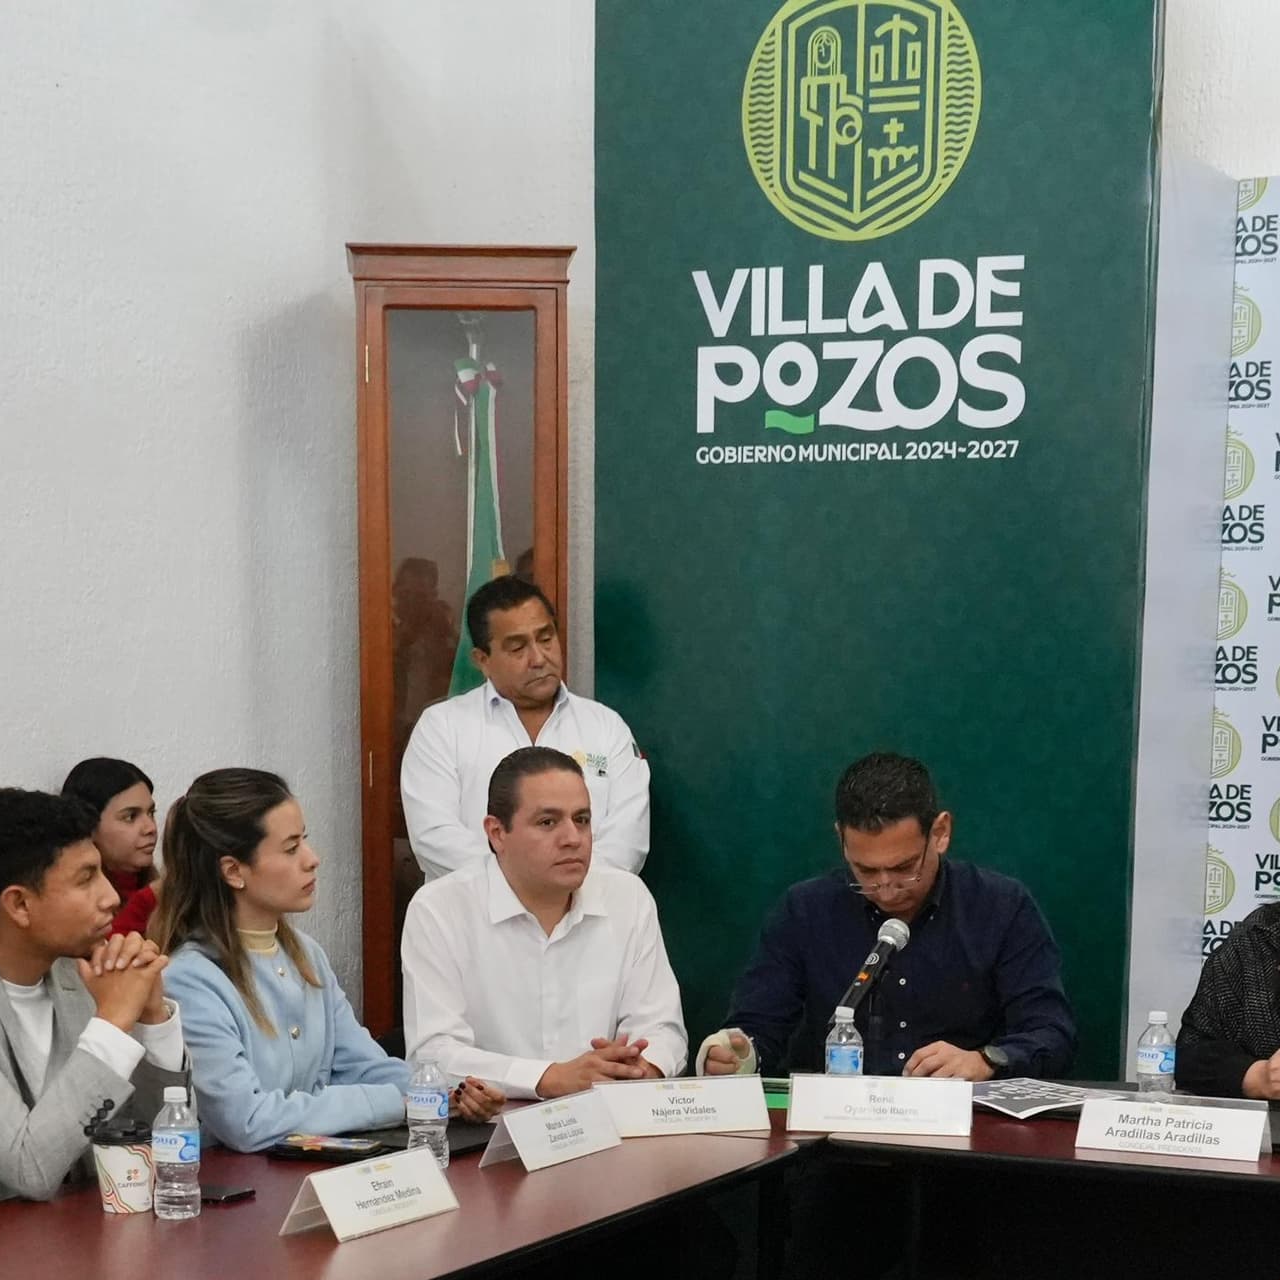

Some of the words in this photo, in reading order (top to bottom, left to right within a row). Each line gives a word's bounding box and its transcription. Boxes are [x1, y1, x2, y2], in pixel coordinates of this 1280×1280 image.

[1252, 215, 1278, 232] DE
[692, 262, 907, 338] VILLA
[918, 255, 1025, 330] DE
[1246, 361, 1271, 377] DE
[696, 445, 796, 464] GOBIERNO
[799, 442, 902, 462] MUNICIPAL
[1239, 505, 1264, 520] DE
[1232, 646, 1258, 661] DE
[1226, 784, 1251, 800] DE
[685, 1105, 717, 1115] Vidales
[1118, 1114, 1161, 1127] Martha
[1165, 1118, 1213, 1131] Patricia
[1105, 1127, 1161, 1140] Aradillas
[1164, 1132, 1221, 1145] Aradillas
